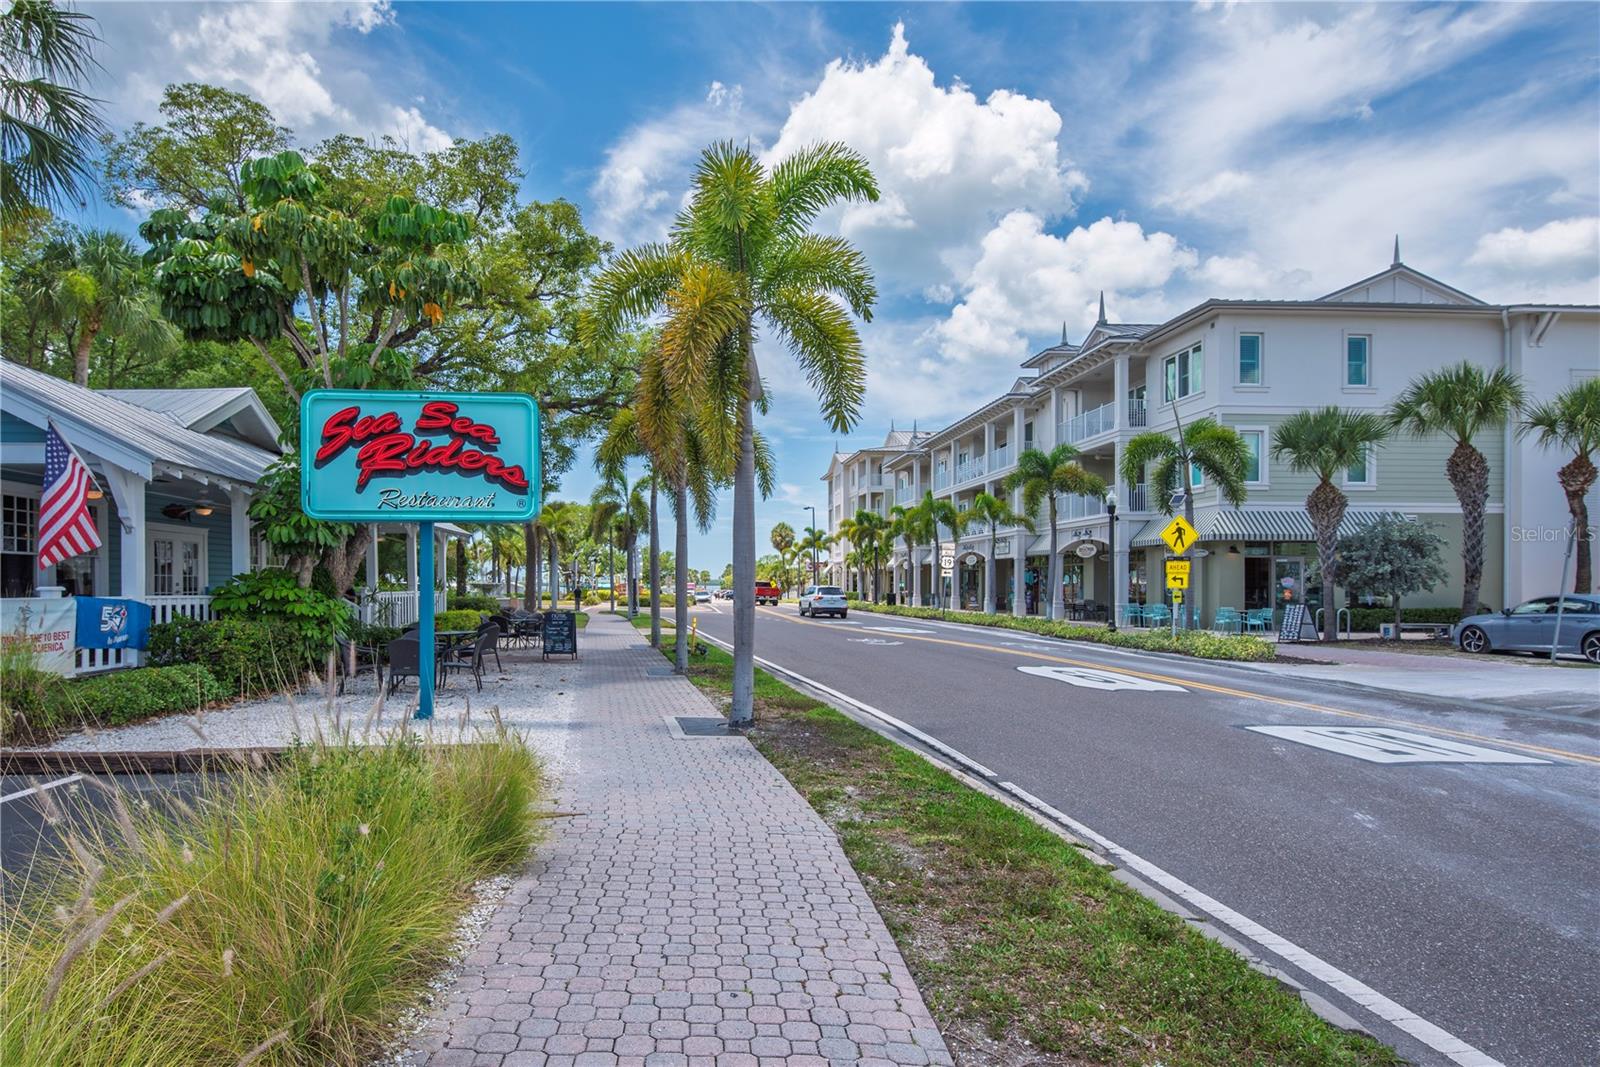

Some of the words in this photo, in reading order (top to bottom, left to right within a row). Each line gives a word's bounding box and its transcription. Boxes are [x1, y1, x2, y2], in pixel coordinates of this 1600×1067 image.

[316, 405, 403, 462] Sea
[414, 401, 500, 446] Sea
[356, 432, 529, 488] Riders
[377, 488, 496, 509] Restaurant
[943, 558, 953, 568] 19
[44, 633, 52, 641] 10
[53, 631, 70, 641] BEST
